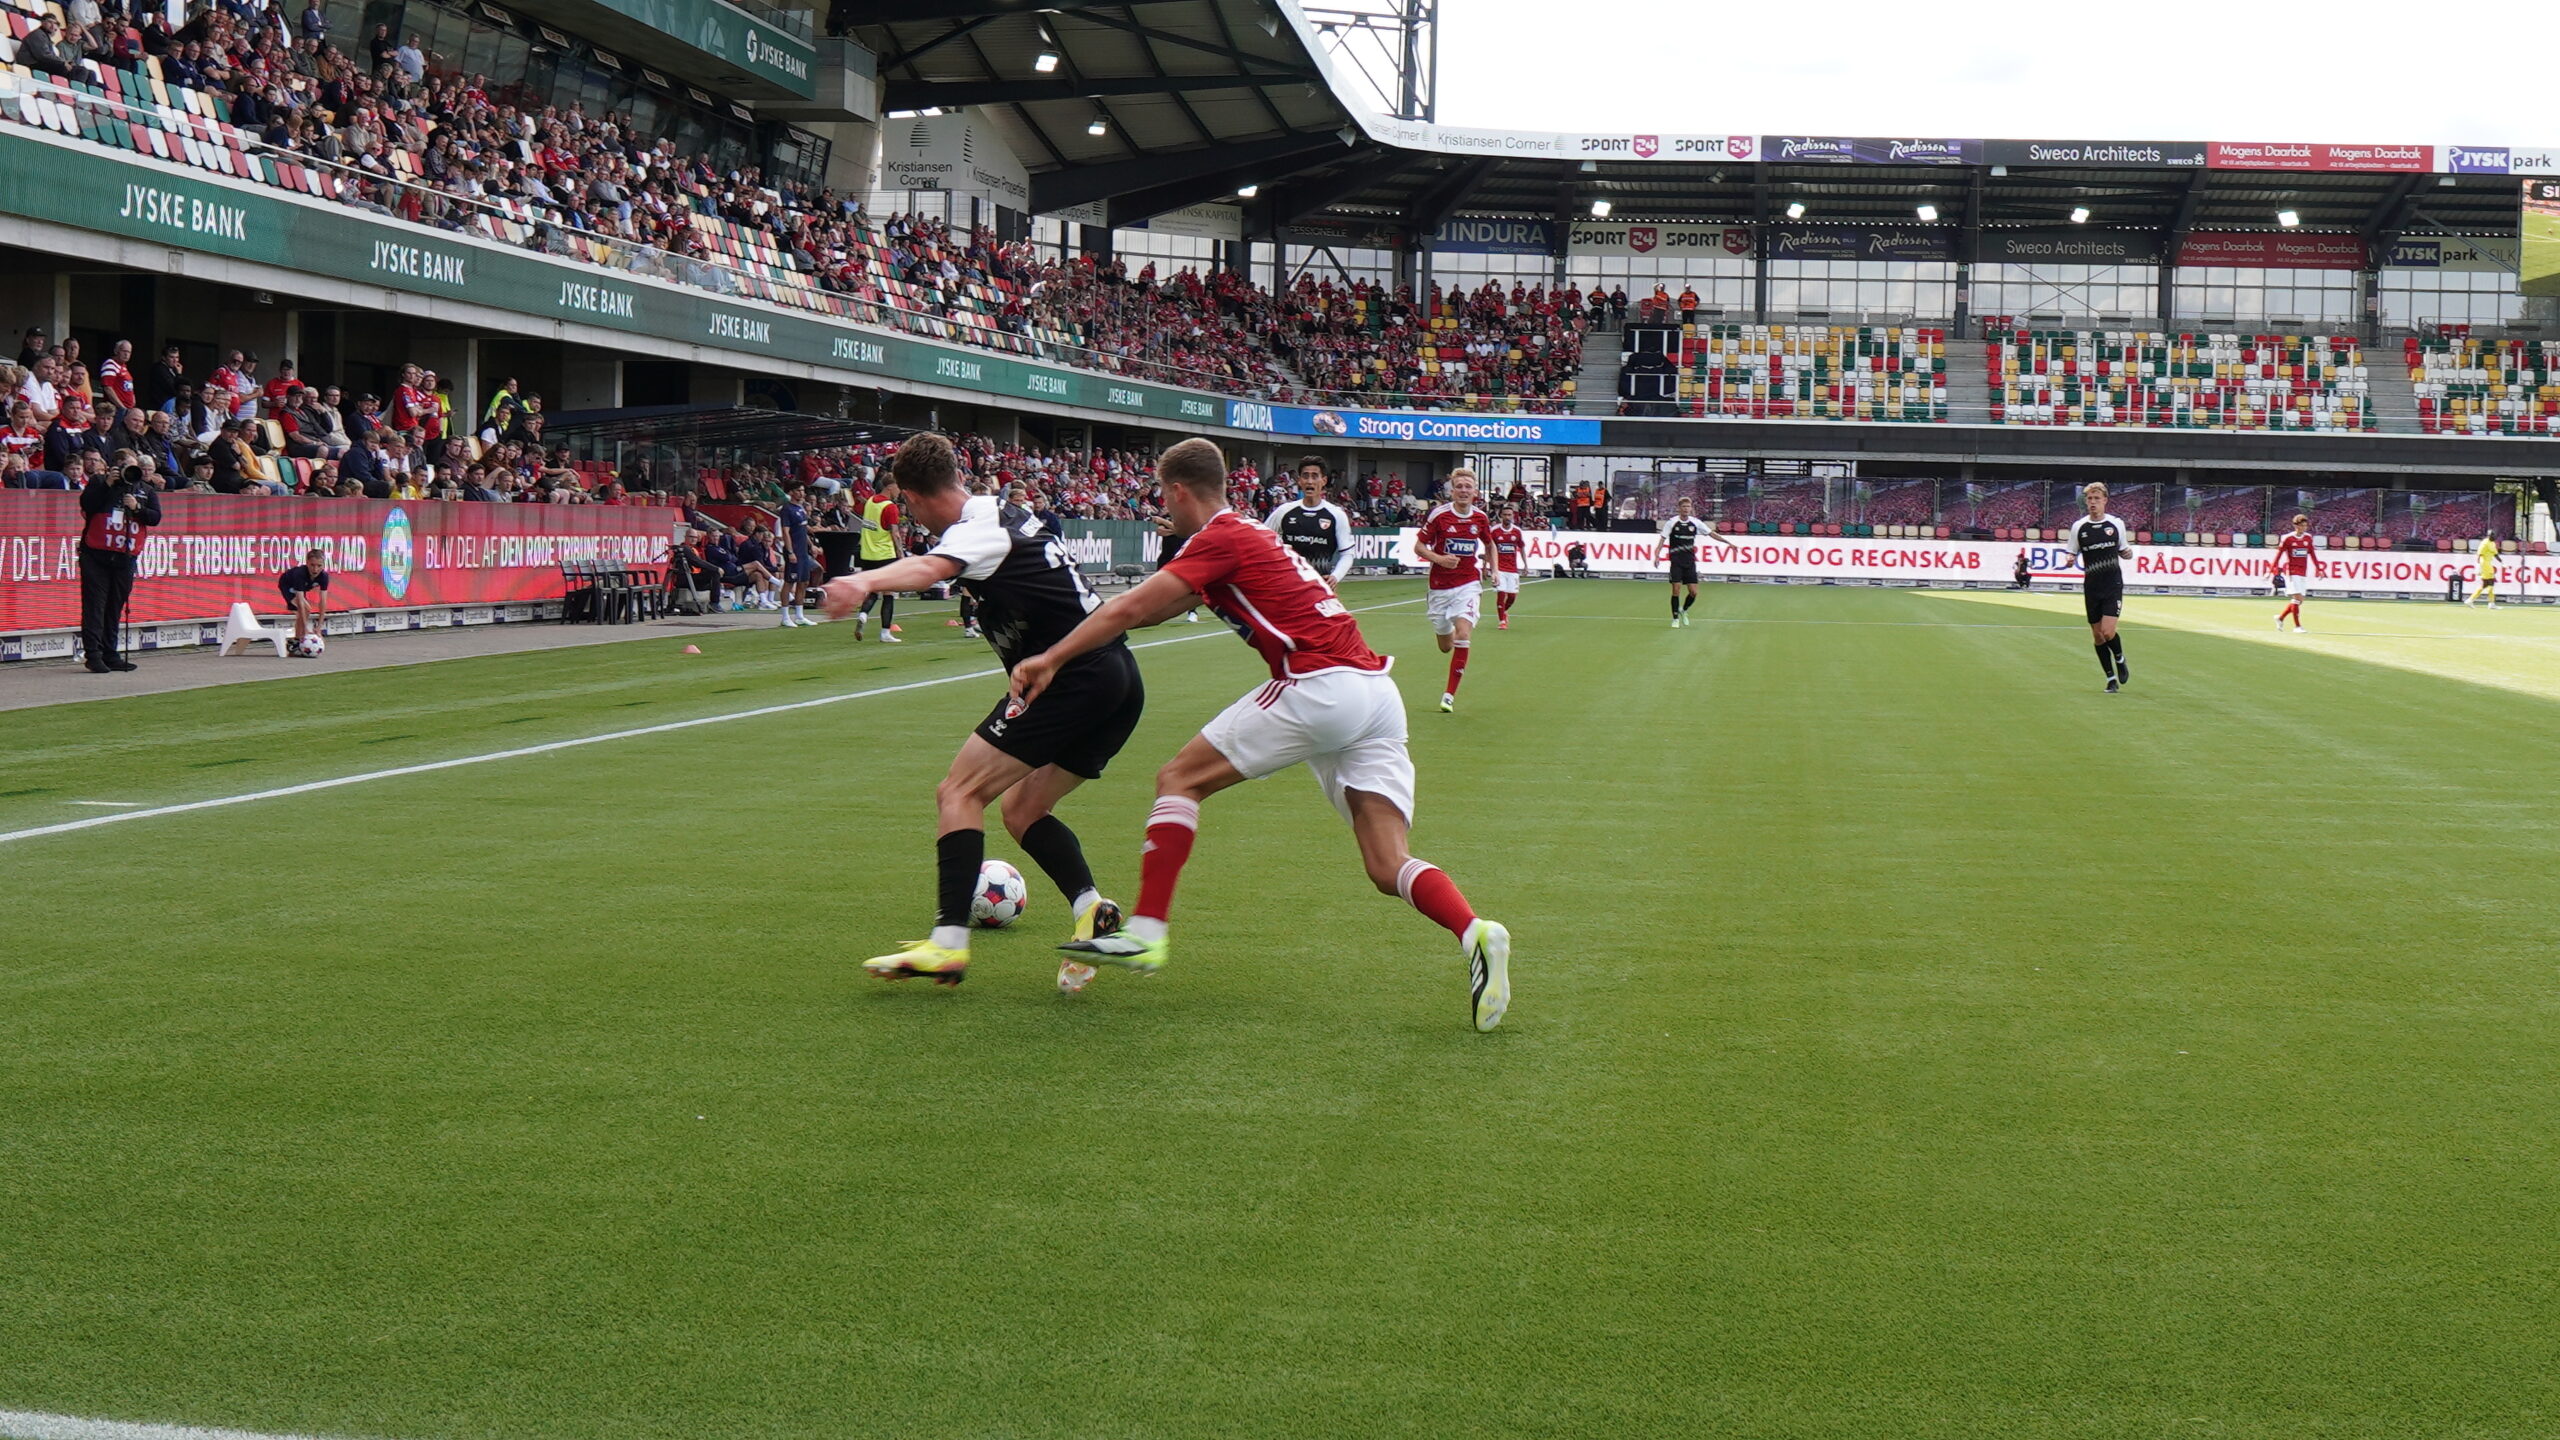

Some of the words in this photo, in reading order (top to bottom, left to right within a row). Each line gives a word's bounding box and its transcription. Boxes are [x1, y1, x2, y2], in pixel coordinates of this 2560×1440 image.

[758, 46, 784, 69] JYSKE
[785, 53, 808, 81] BANK
[1438, 132, 1502, 148] Kristiansen
[1505, 137, 1550, 150] Corner
[1581, 139, 1630, 151] SPORT
[1635, 137, 1657, 152] 24
[1675, 140, 1725, 152] SPORT
[1729, 138, 1752, 153] 24
[1781, 137, 1839, 158] Radisson
[1889, 139, 1947, 160] Radisson
[2029, 145, 2080, 161] Sweco
[2083, 146, 2161, 162] Architects
[2219, 145, 2262, 159] Mogens
[2265, 145, 2312, 157] Daarbak
[2329, 147, 2372, 160] Mogens
[2375, 147, 2422, 159] Daarbak
[2460, 152, 2508, 167] JYSK
[2514, 154, 2552, 170] park
[888, 161, 952, 173] Kristiansen
[120, 183, 185, 229] JYSKE
[192, 198, 247, 241] BANK
[1452, 222, 1546, 244] INDURA
[1572, 231, 1626, 245] SPORT
[1632, 231, 1655, 246] 24
[1666, 232, 1720, 246] SPORT
[1726, 233, 1750, 248] 24
[1779, 230, 1841, 252] Radisson
[1869, 232, 1931, 253] Radisson
[2006, 240, 2051, 254] Sweco
[2055, 241, 2126, 256] Architects
[2182, 241, 2220, 253] Mogens
[2223, 241, 2265, 252] Daarbak
[2276, 243, 2314, 255] Mogens
[2317, 243, 2360, 254] Daarbak
[2396, 247, 2438, 261] JYSK
[2443, 249, 2478, 263] park
[370, 240, 419, 277] JYSKE
[423, 250, 465, 286] BANK
[559, 281, 597, 312] JYSKE
[600, 289, 633, 319] BANK
[708, 313, 741, 339] JYSKE
[743, 320, 771, 345] BANK
[831, 337, 859, 361] JYSKE
[860, 342, 884, 365] BANK
[936, 357, 960, 378] JYSKE
[961, 361, 981, 381] BANK
[1027, 374, 1048, 393] JYSKE
[1049, 377, 1067, 395] BANK
[1107, 388, 1127, 405] JYSKE
[1127, 391, 1144, 407] BANK
[1180, 400, 1198, 415] JYSKE
[1198, 402, 1213, 417] BANK
[1240, 405, 1274, 432] INDURA
[1358, 416, 1414, 441] Strong
[1418, 419, 1542, 440] Connections
[106, 516, 139, 535] FOO
[426, 535, 454, 569] BLIV
[457, 535, 480, 569] DEL
[482, 535, 498, 568] AF
[500, 535, 524, 568] DEN
[526, 535, 555, 569] RØDE
[622, 535, 633, 564] 90
[1064, 531, 1112, 571] vendborg
[1353, 534, 1401, 560] URITZ
[1452, 542, 1475, 552] JYSK
[13, 535, 51, 581] DEL
[56, 535, 82, 580] AF
[182, 535, 256, 575] TRIBUNE
[260, 535, 291, 574] FOR
[1807, 547, 1844, 566] OG
[1851, 549, 1982, 570] REGNSKAB
[2315, 560, 2432, 581] REVISION
[2439, 564, 2476, 582] OG
